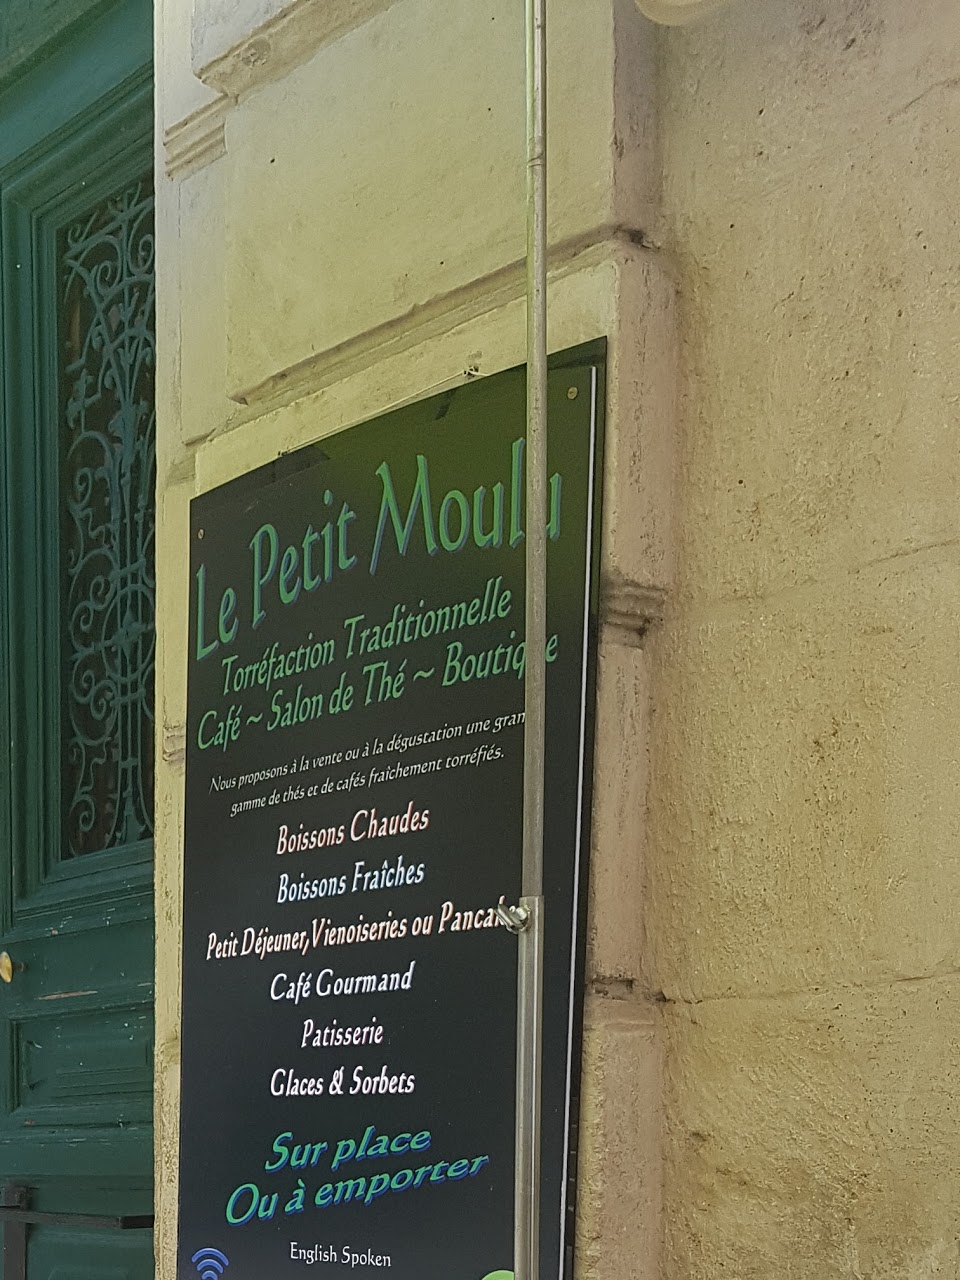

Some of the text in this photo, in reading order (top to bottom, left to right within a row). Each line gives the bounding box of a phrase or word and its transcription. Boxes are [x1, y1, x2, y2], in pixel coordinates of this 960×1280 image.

[196, 564, 240, 661] Le
[249, 490, 357, 630] Petit
[221, 576, 512, 696] Torréfaction Traditionnelle
[198, 706, 242, 753] Café
[266, 686, 322, 732] Salon
[328, 672, 354, 714] de
[362, 659, 406, 706] Thé
[442, 630, 559, 688] Boutiqe
[209, 711, 526, 794] Nous proposons à la vente ou à la dégustation une gran
[230, 795, 266, 817] gamme
[268, 789, 280, 805] de
[283, 783, 305, 803] thés
[307, 784, 318, 797] et
[321, 777, 334, 794] de
[336, 770, 365, 792] cafés
[445, 745, 504, 769] torréfiés.
[276, 801, 430, 855] Boissons Chaudes
[277, 854, 425, 904] Boissons Fraîches
[206, 929, 238, 961] Petit
[412, 914, 433, 937] ou
[270, 960, 416, 1005] Café Gourmand
[301, 1016, 384, 1049] Patisserie
[270, 1064, 415, 1097] Glaces & Sorbets
[264, 1124, 432, 1174] Sur place
[225, 1152, 490, 1227] Ou à emporter
[289, 1241, 392, 1269] English Spoken
